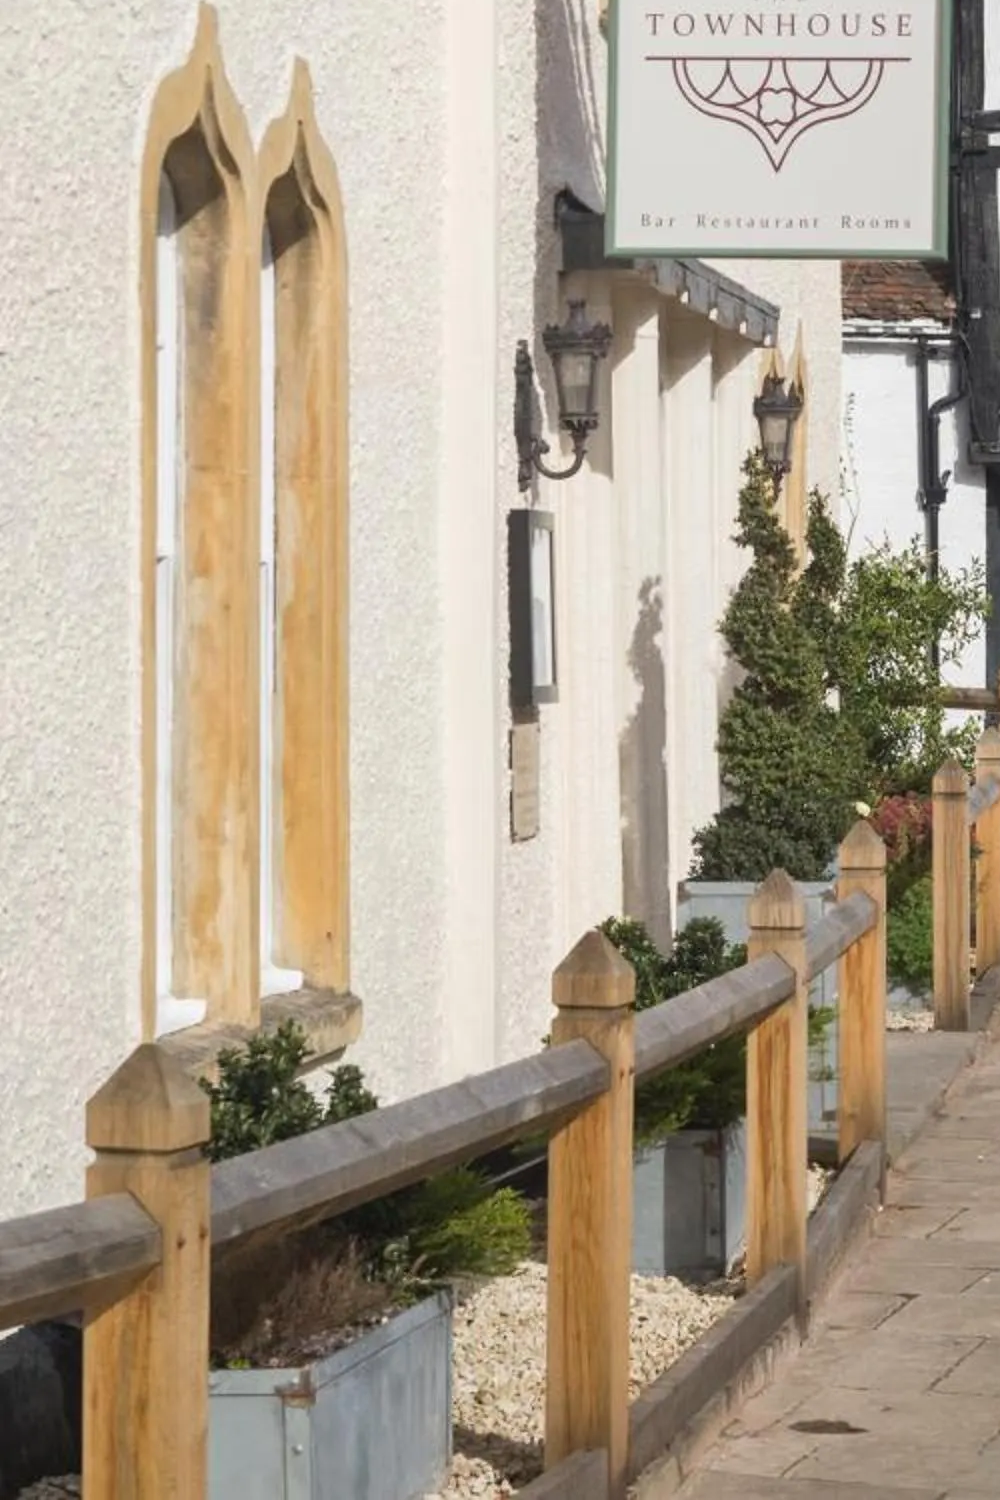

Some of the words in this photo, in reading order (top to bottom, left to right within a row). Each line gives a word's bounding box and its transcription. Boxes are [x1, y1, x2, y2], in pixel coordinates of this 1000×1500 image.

[645, 12, 912, 37] TOWNHOUSE
[641, 213, 676, 228] Bar
[696, 214, 820, 229] Restaurant
[841, 215, 912, 230] Rooms
